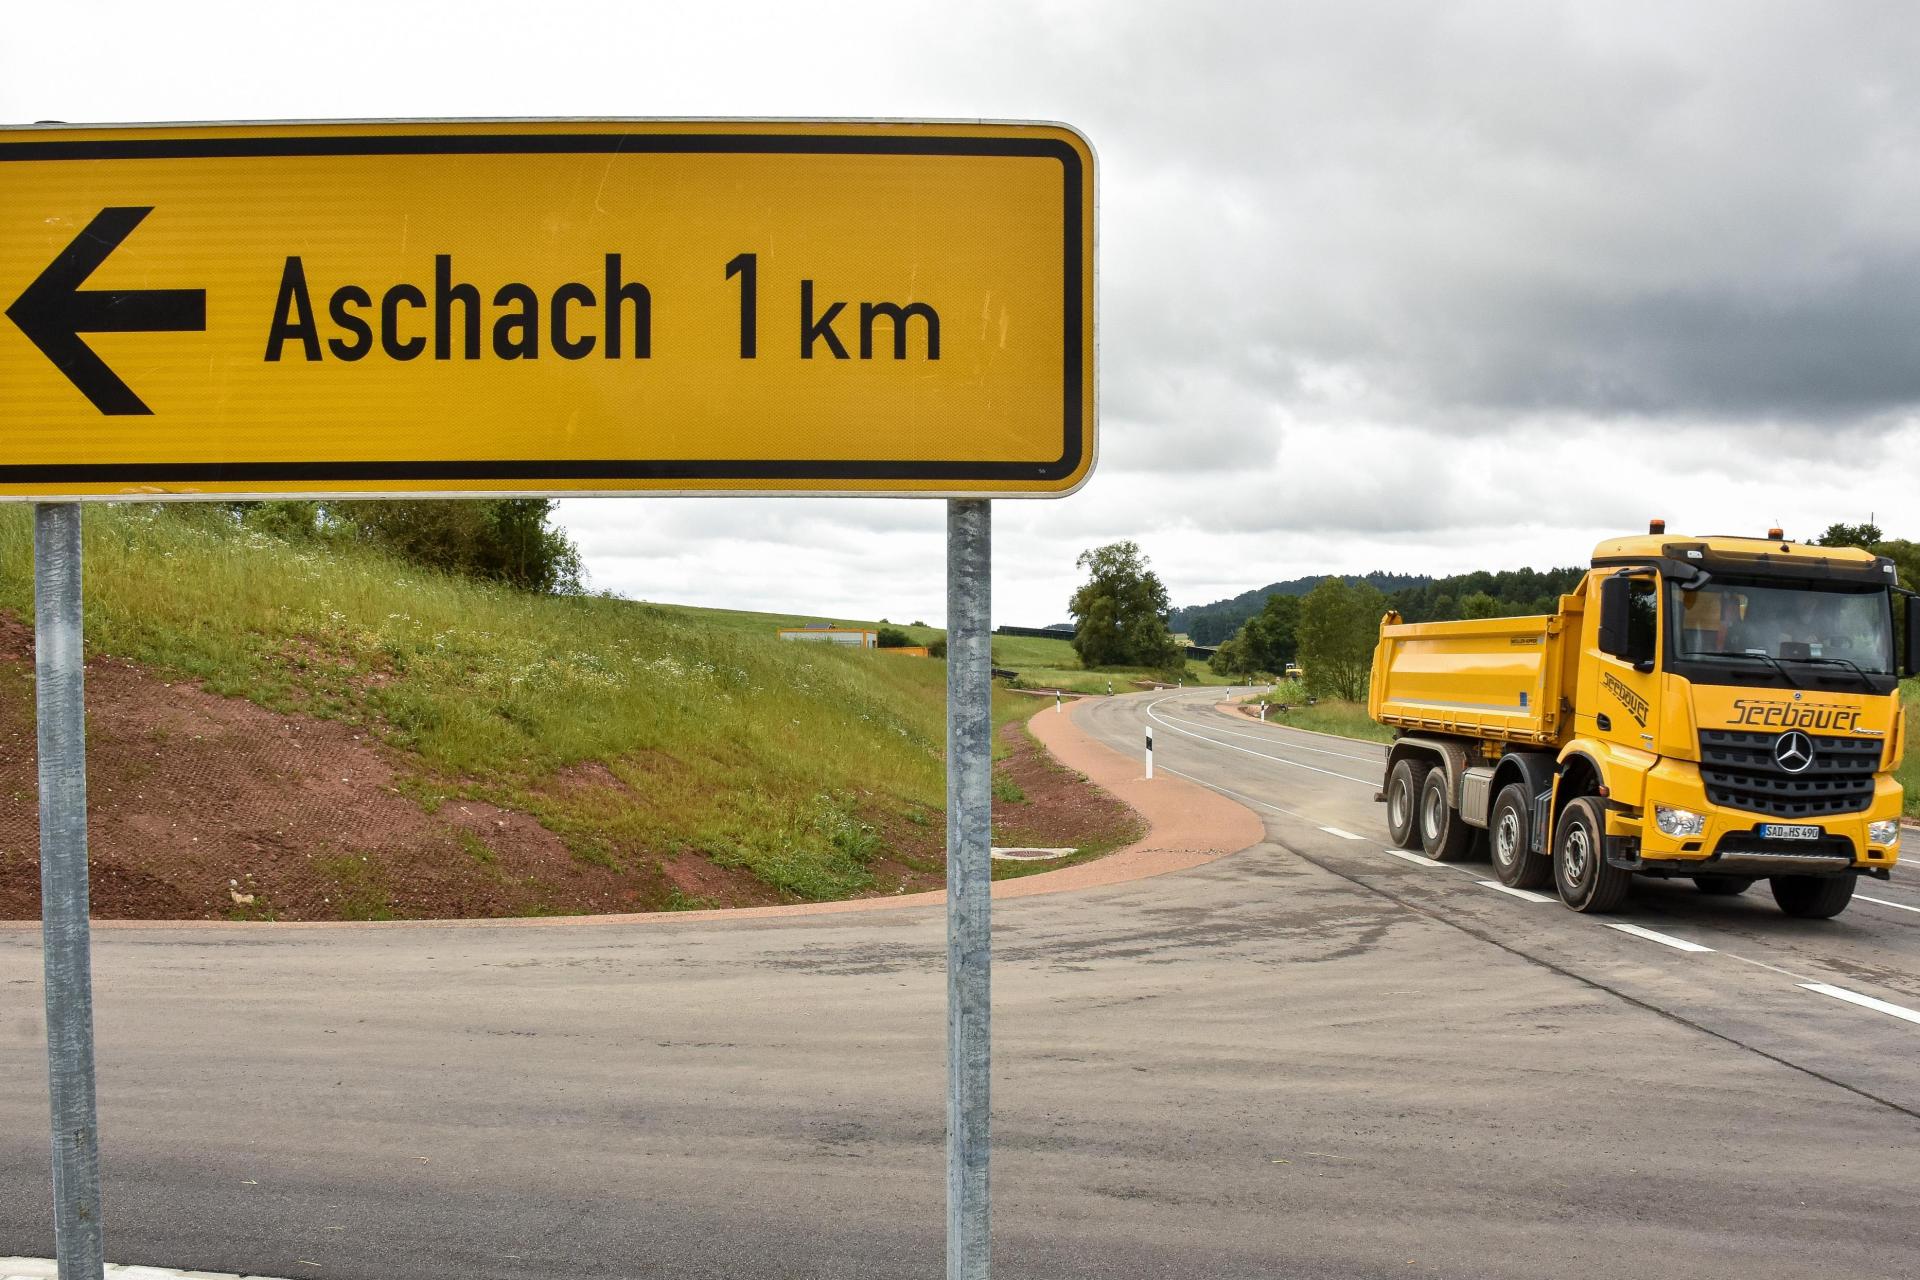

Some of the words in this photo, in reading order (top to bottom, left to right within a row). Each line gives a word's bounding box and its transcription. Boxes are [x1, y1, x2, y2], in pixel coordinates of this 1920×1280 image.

[264, 253, 651, 362] Aschach
[725, 253, 756, 359] 1
[800, 280, 940, 361] km
[1602, 672, 1649, 723] Seebauer
[1726, 699, 1861, 730] Seebauer
